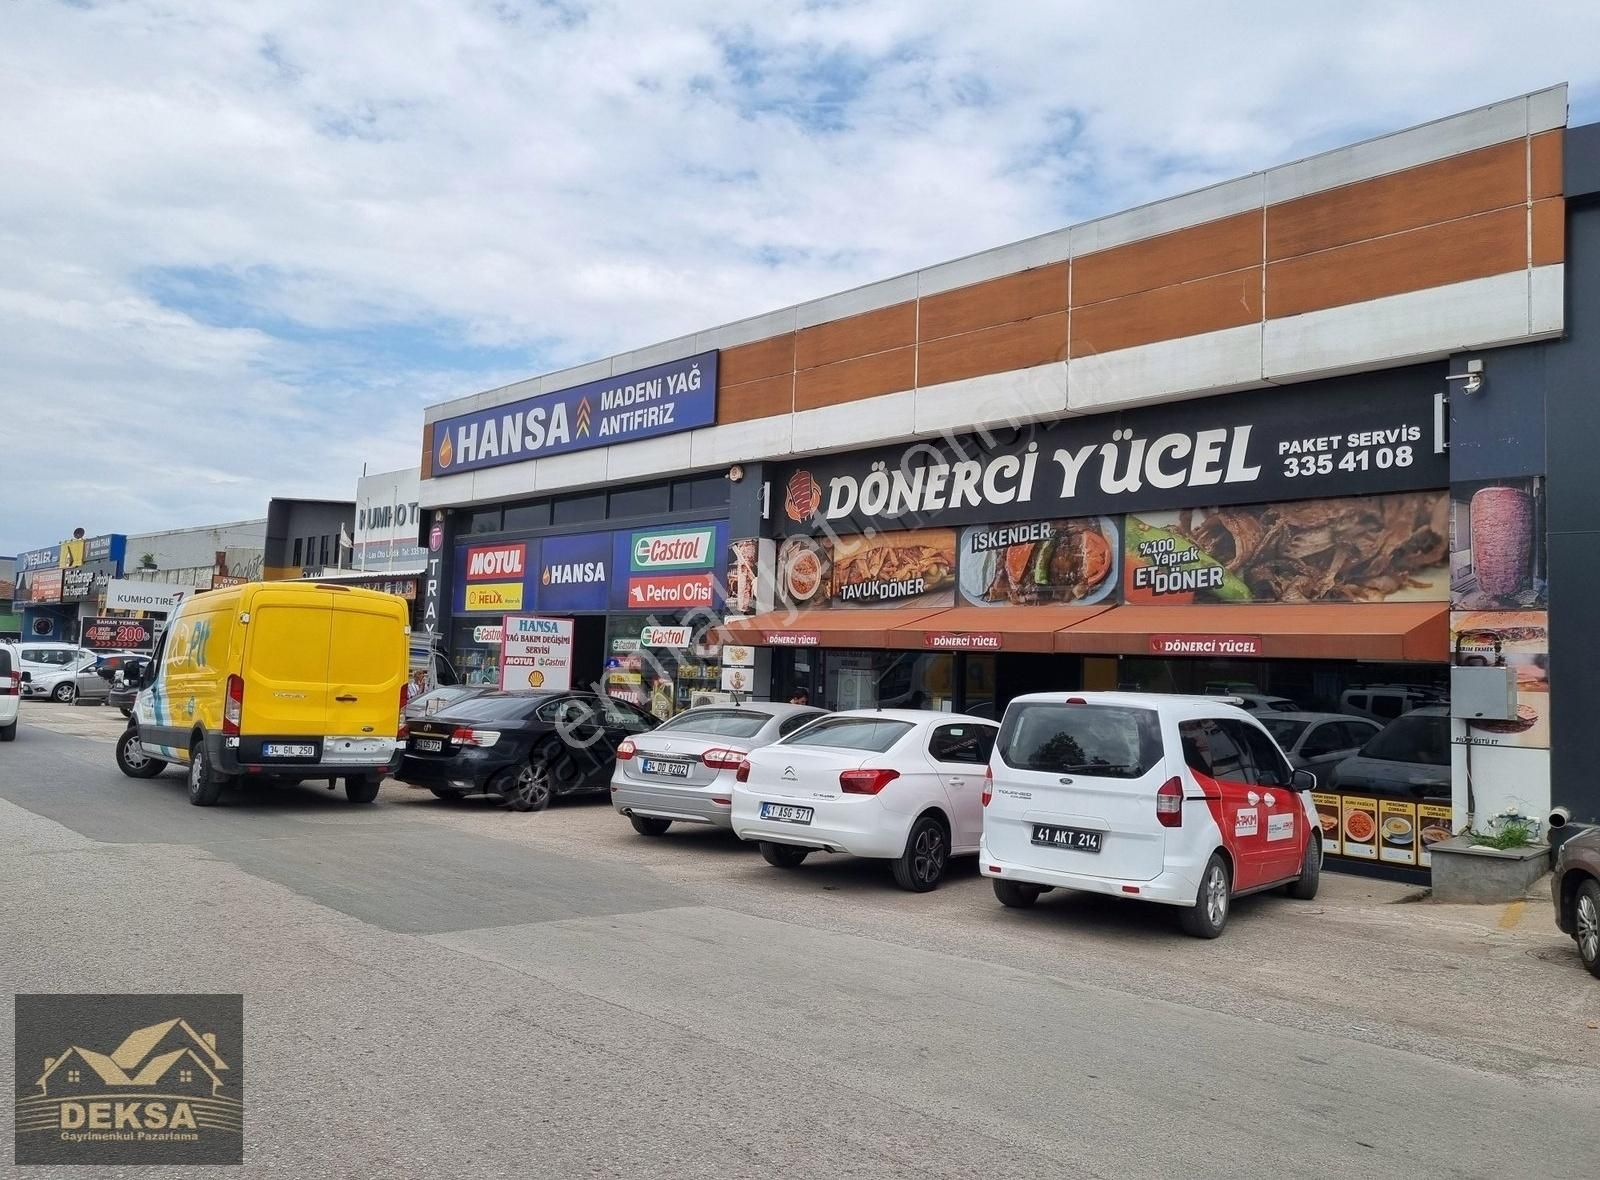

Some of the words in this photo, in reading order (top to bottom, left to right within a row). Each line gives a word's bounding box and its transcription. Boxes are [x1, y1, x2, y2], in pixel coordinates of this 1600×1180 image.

[667, 363, 702, 393] YAĞ
[456, 402, 570, 464] HANSA
[1278, 435, 1342, 456] PAKET
[1347, 424, 1422, 448] SERVİS
[1283, 454, 1333, 478] 335
[1338, 449, 1368, 473] 41
[1375, 446, 1414, 470] 08
[825, 441, 1039, 521] DÖNERCİ
[1053, 424, 1262, 498] YÜCEL
[973, 523, 1050, 551] İSKENDER
[650, 537, 700, 562] Castrol
[1140, 539, 1175, 555] %100
[470, 550, 521, 575] MOTUL
[1153, 548, 1198, 567] Yaprak
[551, 562, 606, 584] HANSA
[1135, 566, 1157, 587] ET
[1155, 566, 1223, 591] DÖNER
[647, 581, 681, 601] Petrol
[683, 580, 712, 600] Ofisi
[841, 581, 880, 600] TAVUK
[879, 578, 925, 600] DÖNER
[117, 595, 152, 604] KUMHO
[155, 597, 174, 606] TIRE
[479, 594, 502, 604] HELIX
[86, 627, 97, 640] 4
[519, 620, 558, 633] HANSA
[506, 634, 520, 643] YAĞ
[521, 635, 541, 643] BAKIM
[651, 629, 685, 644] Castrol
[933, 634, 971, 647] DÖNERCİ
[970, 635, 998, 647] YÜCEL
[525, 646, 550, 654] SERVİSİ
[1164, 638, 1216, 653] DÖNERCİ
[1218, 641, 1256, 653] YÜCEL
[505, 658, 535, 666] MOTUL
[269, 745, 278, 754] 34
[299, 745, 314, 755] 250
[648, 762, 655, 771] 34
[668, 764, 686, 775] 8202
[767, 806, 776, 816] 41
[779, 807, 793, 818] ASG
[795, 809, 810, 820] 571
[1037, 827, 1050, 841] 41
[1053, 830, 1075, 845] AKT
[1078, 833, 1097, 848] 214
